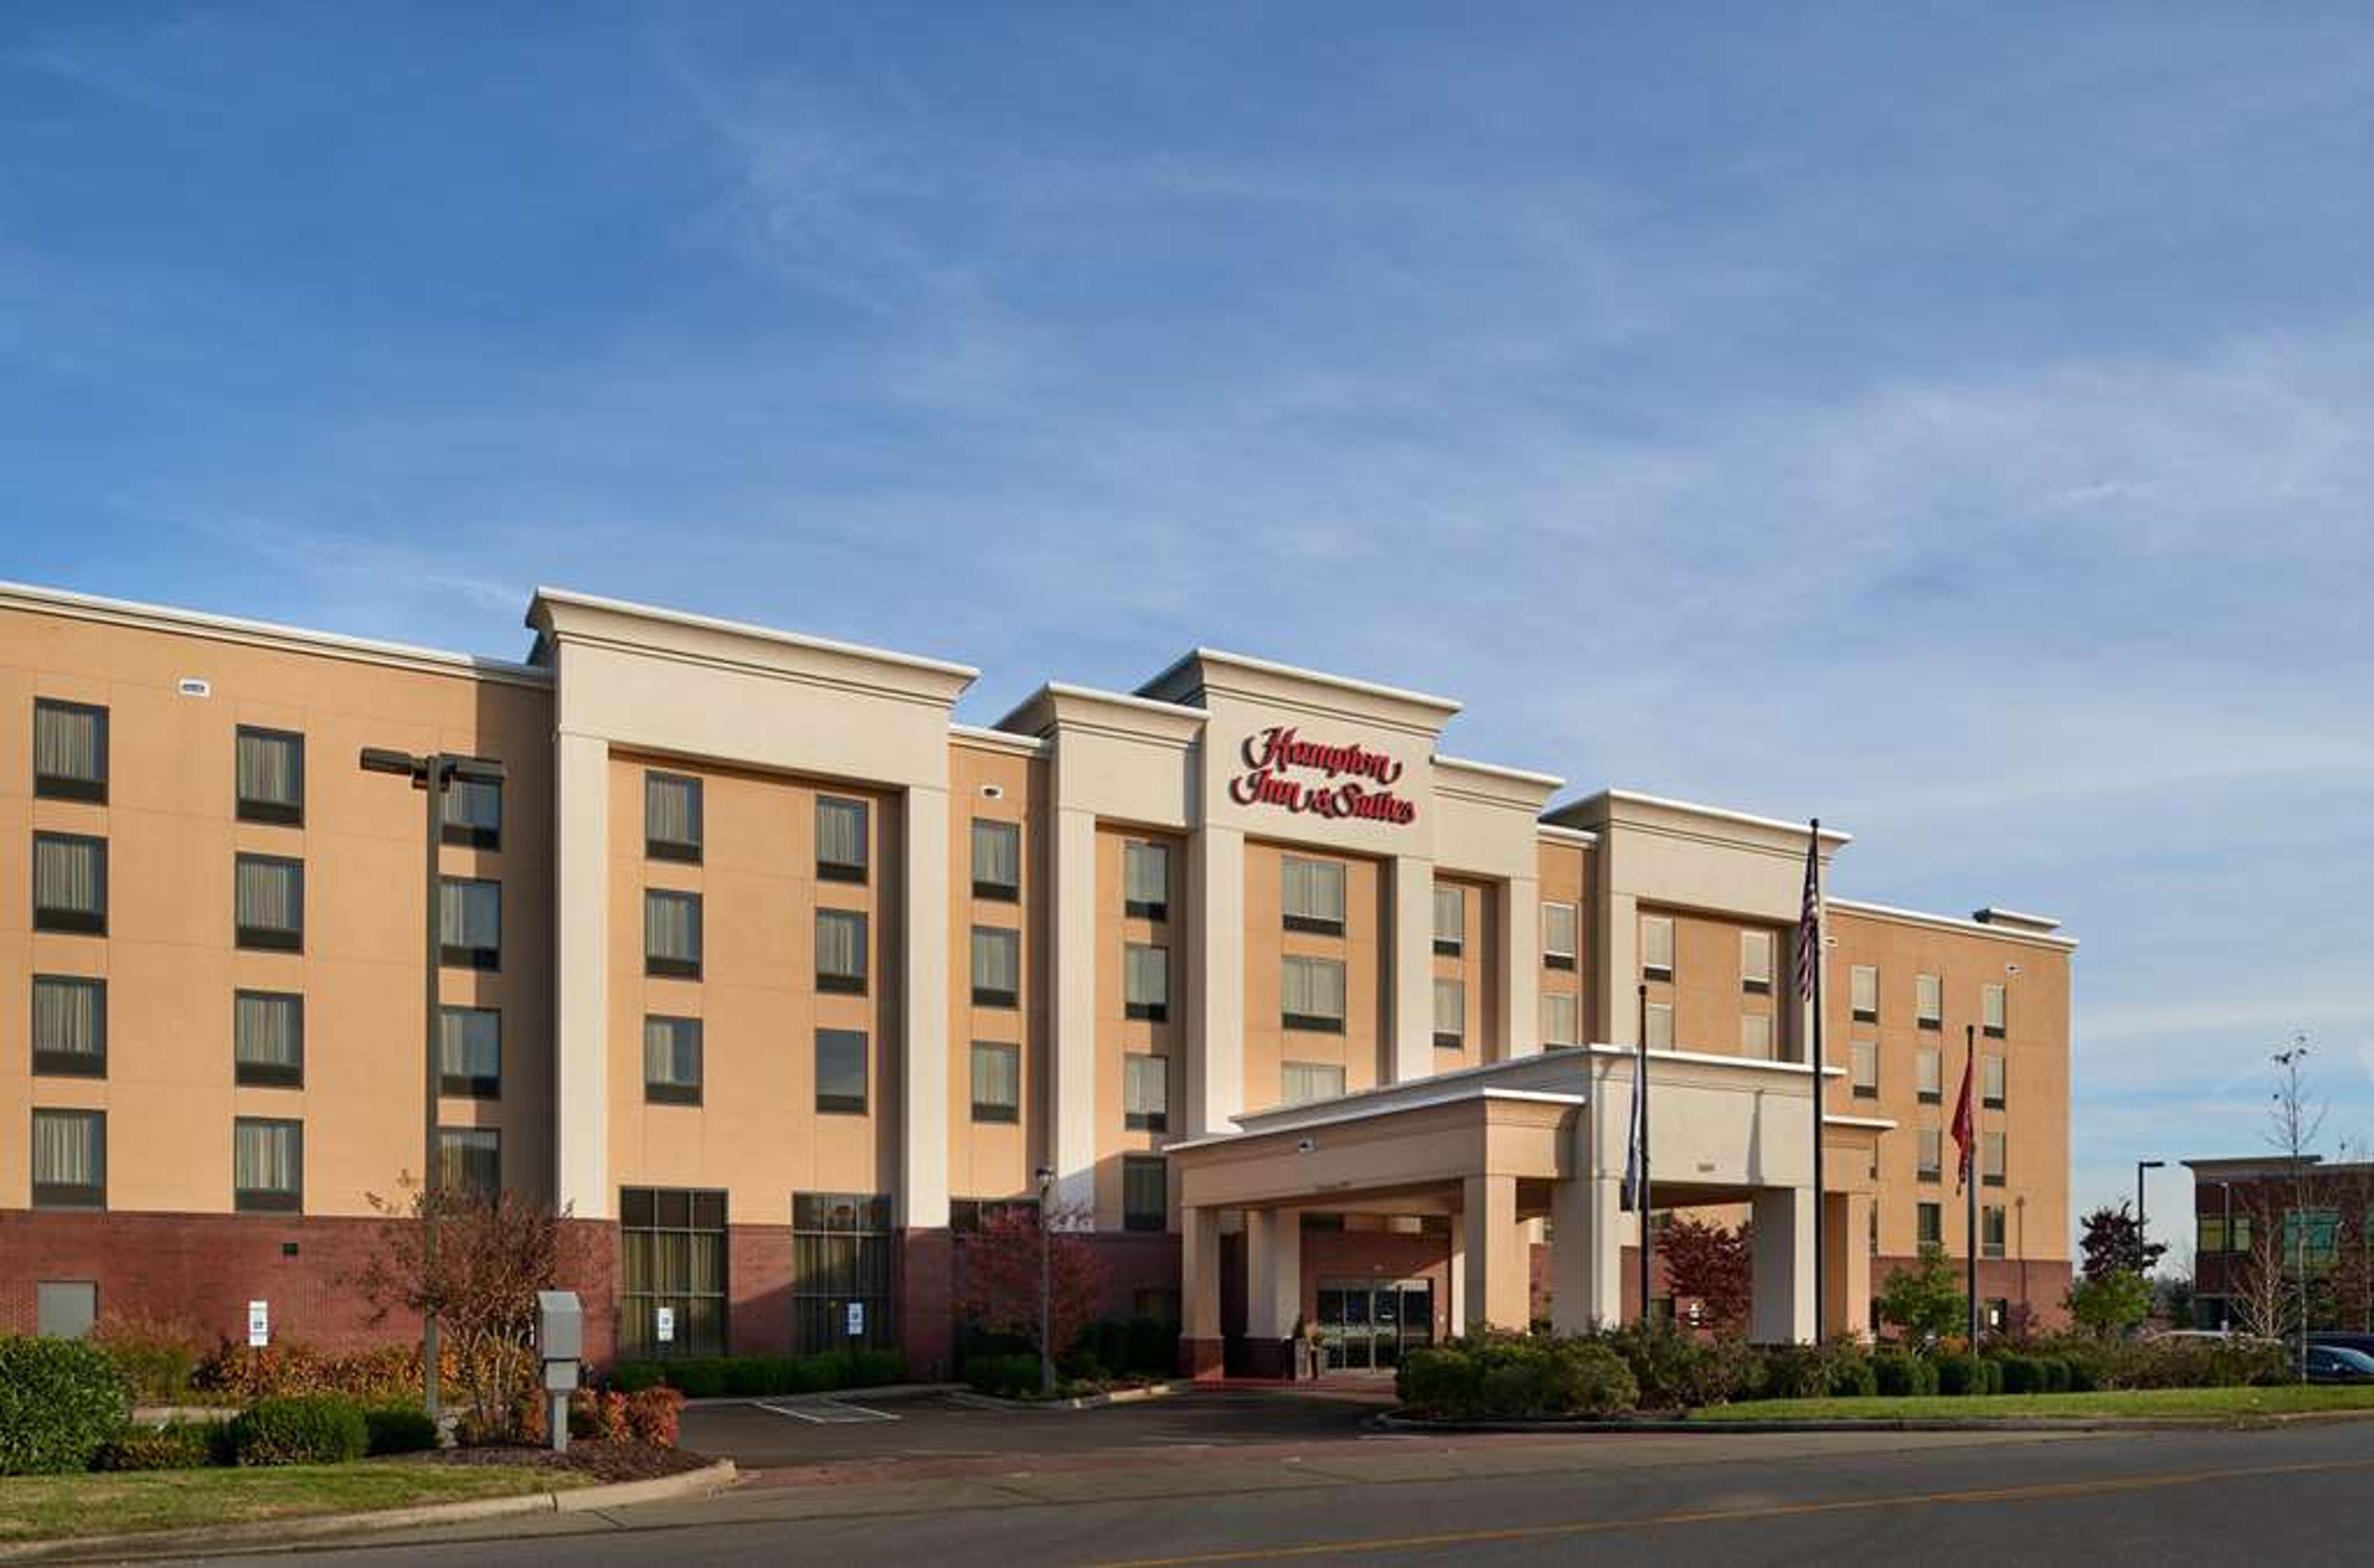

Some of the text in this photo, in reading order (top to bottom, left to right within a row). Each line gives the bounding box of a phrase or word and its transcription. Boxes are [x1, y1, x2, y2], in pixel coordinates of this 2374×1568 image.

[1241, 726, 1402, 785] Hampton
[1229, 770, 1313, 813] Inn
[1332, 782, 1415, 825] Suites
